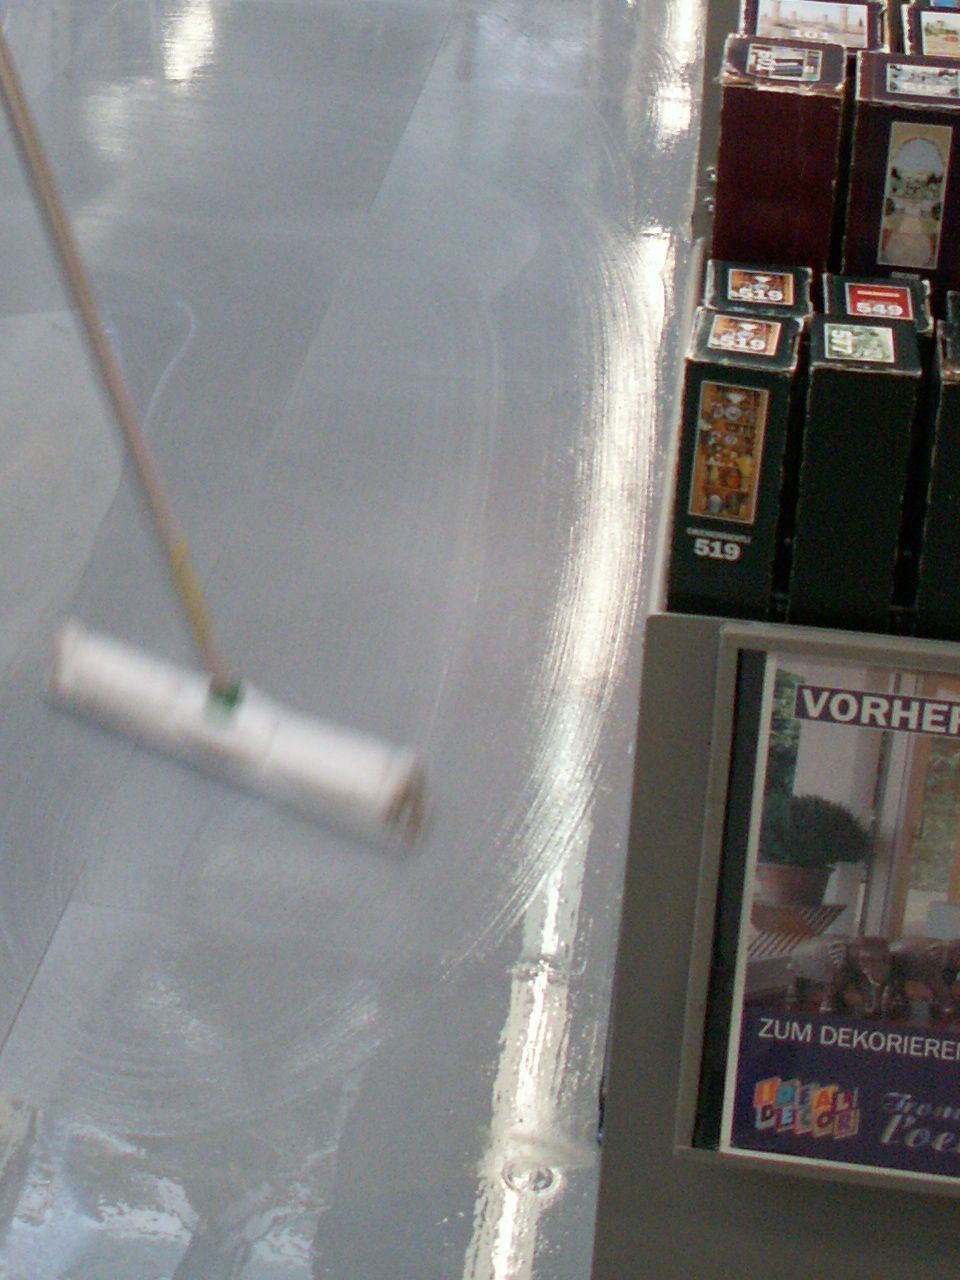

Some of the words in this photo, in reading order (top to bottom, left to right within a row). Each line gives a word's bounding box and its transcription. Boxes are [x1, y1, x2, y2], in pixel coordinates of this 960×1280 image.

[738, 287, 783, 301] 519
[720, 333, 766, 351] 519
[693, 538, 741, 562] 519
[758, 1018, 812, 1043] ZUM
